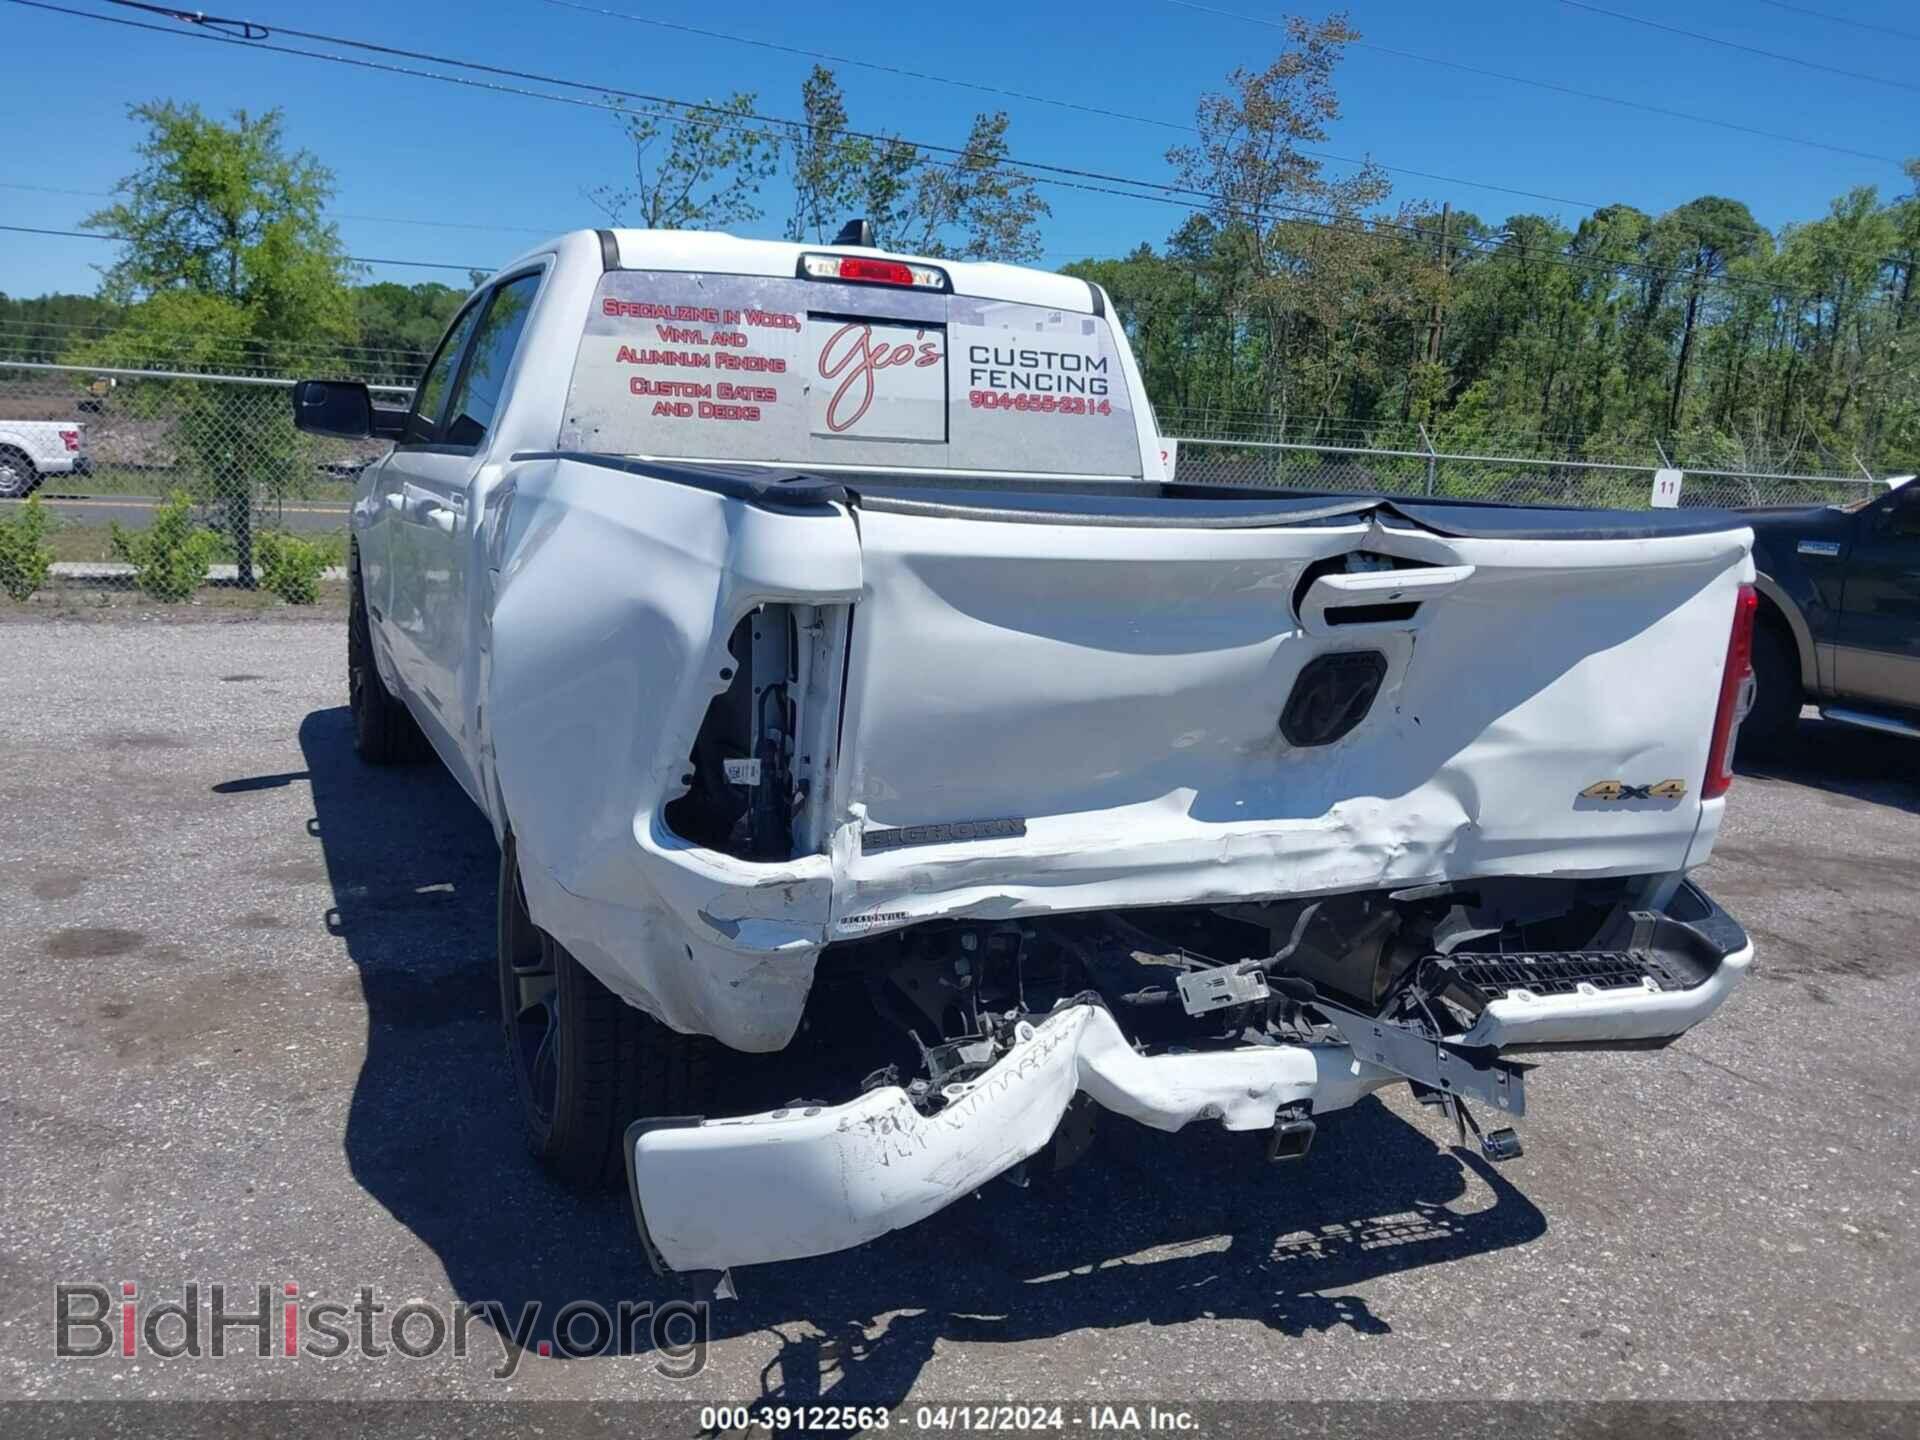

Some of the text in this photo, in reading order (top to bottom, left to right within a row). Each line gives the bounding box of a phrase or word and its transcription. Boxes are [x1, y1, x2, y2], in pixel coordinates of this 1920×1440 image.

[969, 346, 1108, 374] CUSTOM
[970, 369, 1109, 396] FENCING
[1660, 480, 1675, 495] 11
